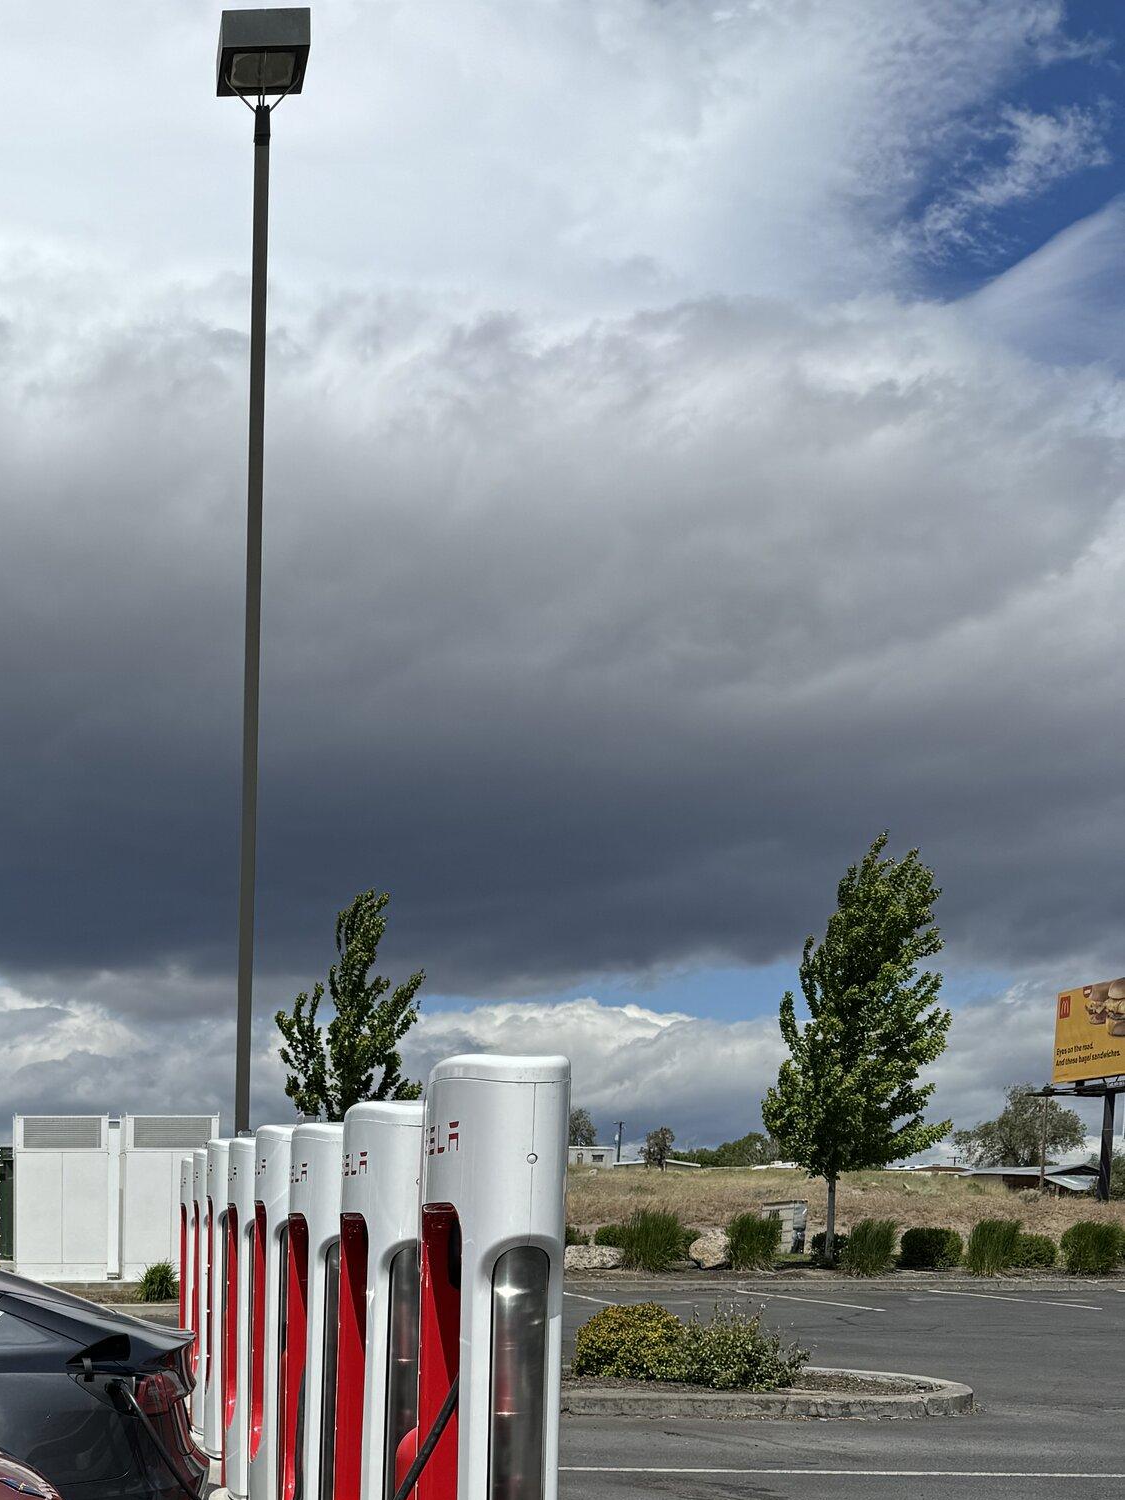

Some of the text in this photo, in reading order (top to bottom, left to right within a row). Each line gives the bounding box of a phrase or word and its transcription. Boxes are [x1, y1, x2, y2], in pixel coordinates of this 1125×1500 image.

[1056, 1046, 1068, 1057] Eyes
[1074, 1043, 1082, 1053] the
[1055, 1057, 1066, 1068] And
[1065, 1055, 1078, 1066] these
[1078, 1052, 1092, 1065] bagel
